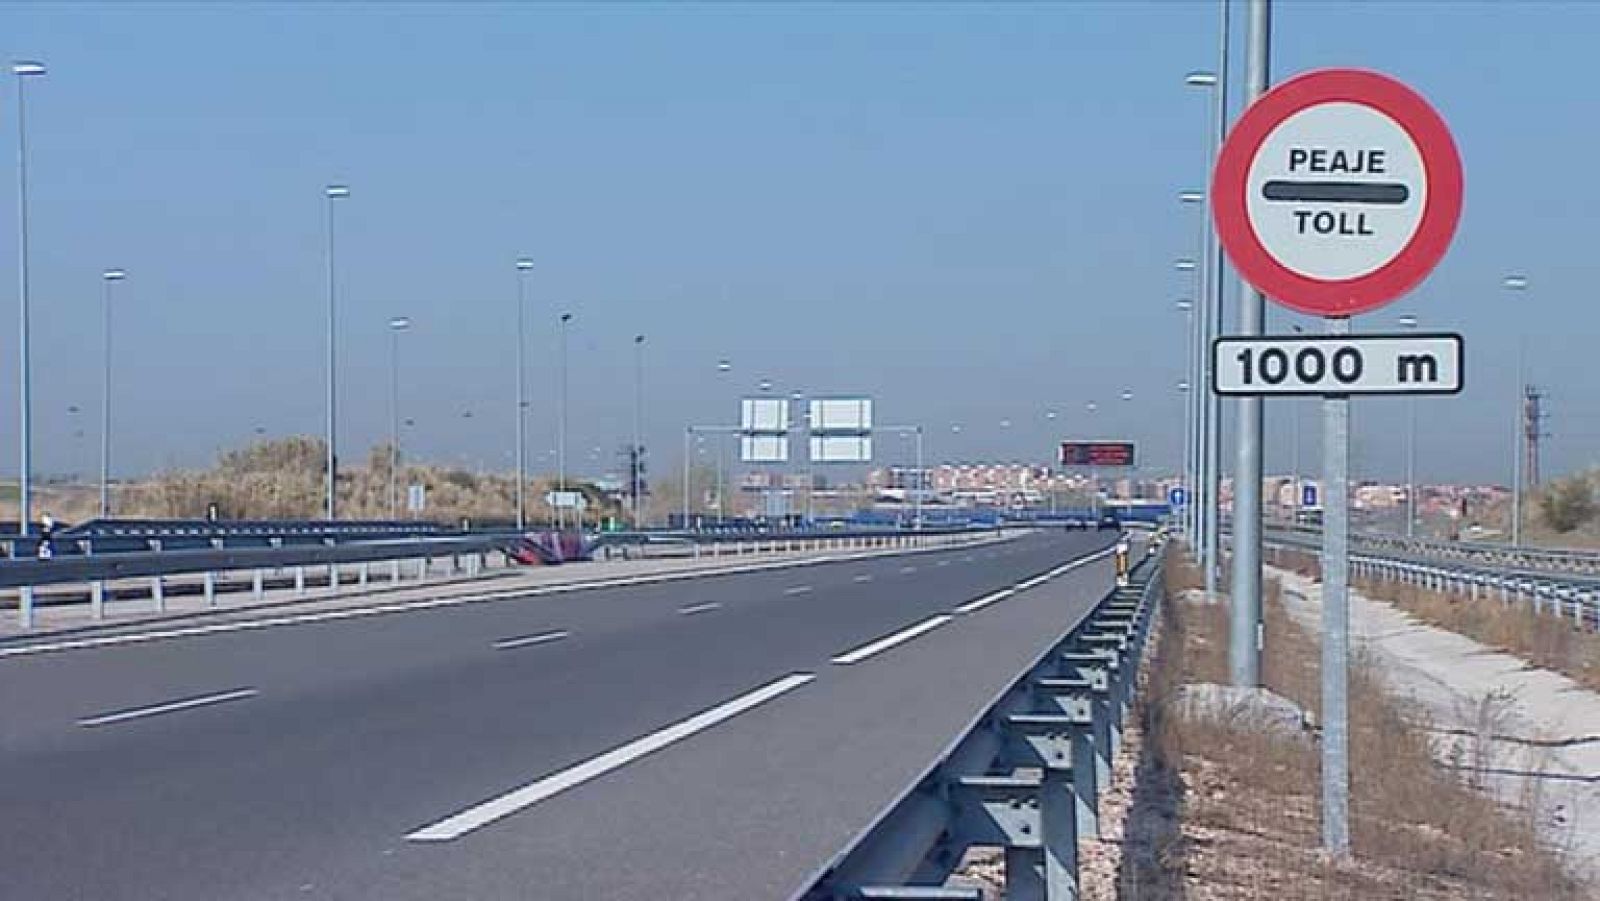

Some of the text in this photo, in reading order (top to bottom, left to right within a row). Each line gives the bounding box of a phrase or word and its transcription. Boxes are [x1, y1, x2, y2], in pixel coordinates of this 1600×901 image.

[1289, 149, 1385, 174] PEAJE
[1293, 210, 1374, 235] TOLL
[1236, 347, 1438, 385] 1000 m
